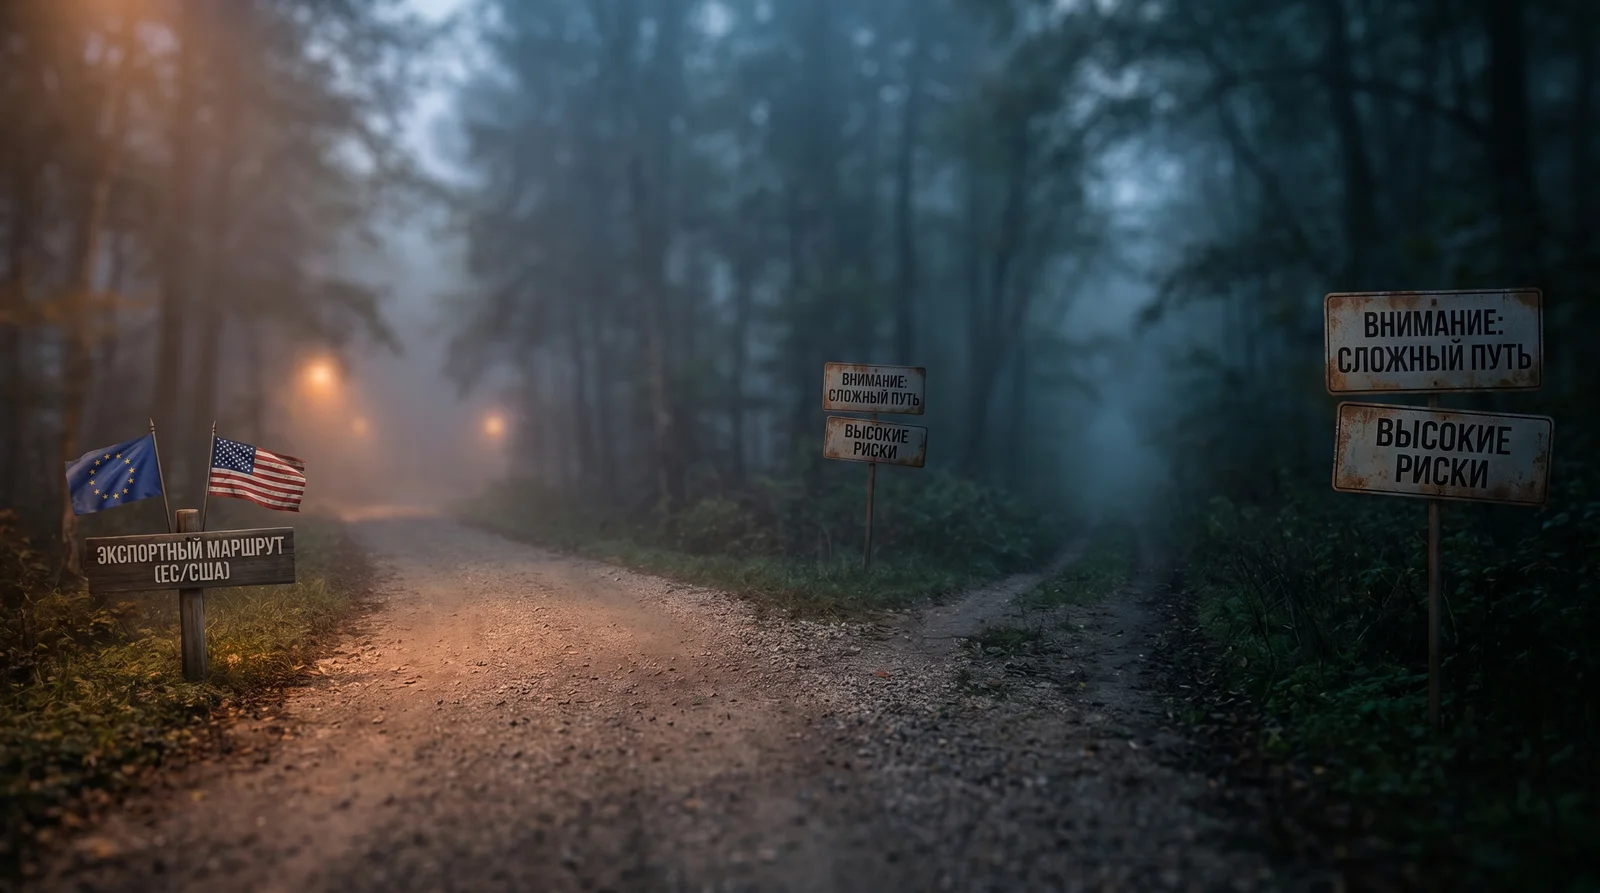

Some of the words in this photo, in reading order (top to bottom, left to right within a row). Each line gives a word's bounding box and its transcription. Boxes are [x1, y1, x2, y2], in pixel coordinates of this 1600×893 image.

[1364, 309, 1504, 338] ВНИМАНИЕ:
[1337, 339, 1464, 373] СЛОЖНЫЙ
[1471, 343, 1532, 370] ПУТЬ
[842, 373, 908, 389] ВНИМАНИЕ:
[828, 389, 888, 405] СЛОЖНЫЙ
[891, 392, 920, 406] ПУТЬ
[844, 424, 910, 444] ВЫСОКИЕ
[1376, 417, 1512, 455] ВЫСОКИЕ
[853, 441, 898, 459] РИСКИ
[1395, 454, 1489, 489] РИСКИ
[97, 537, 203, 565] ЭКСПОРТНЫЙ
[207, 536, 285, 559] МАРШРУТ
[154, 561, 230, 583] (ЕС/США)
